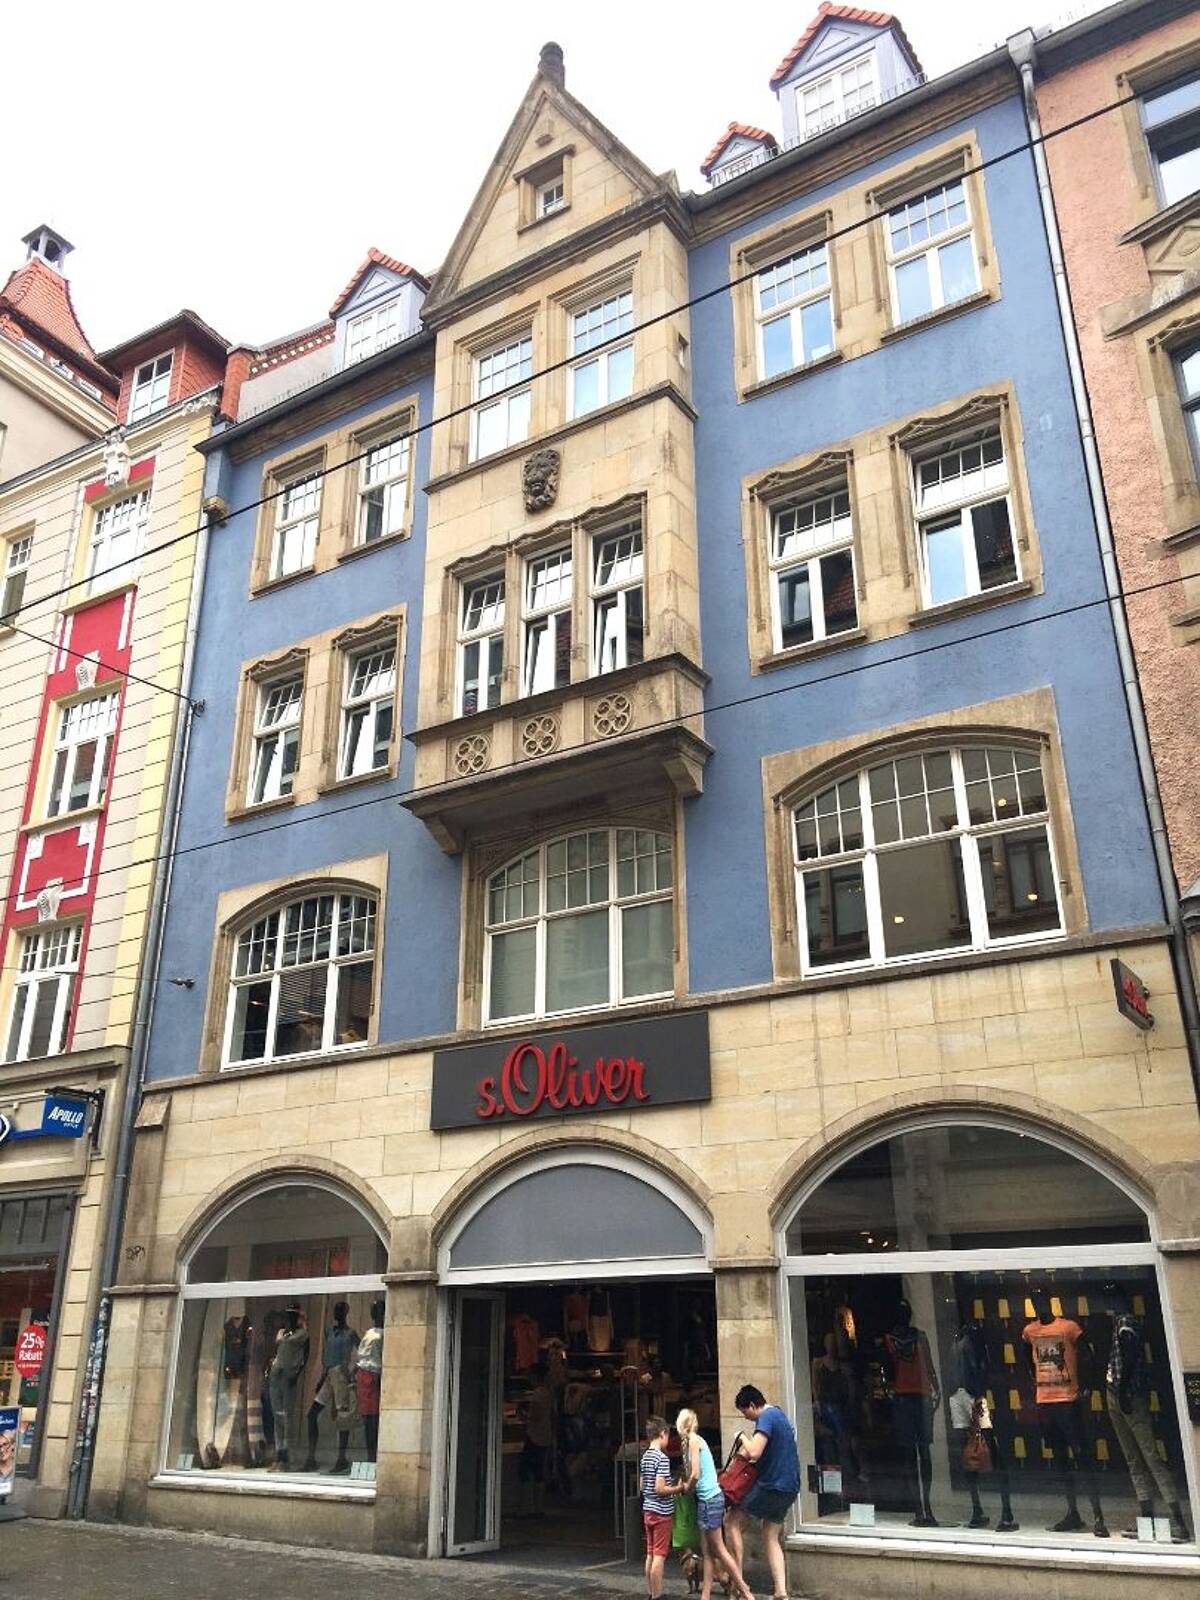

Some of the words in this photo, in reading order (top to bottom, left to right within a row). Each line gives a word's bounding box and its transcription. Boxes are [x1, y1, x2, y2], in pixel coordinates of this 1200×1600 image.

[476, 1041, 650, 1118] s.Oliver
[20, 1332, 45, 1349] 25%
[19, 1350, 43, 1361] Rabatt
